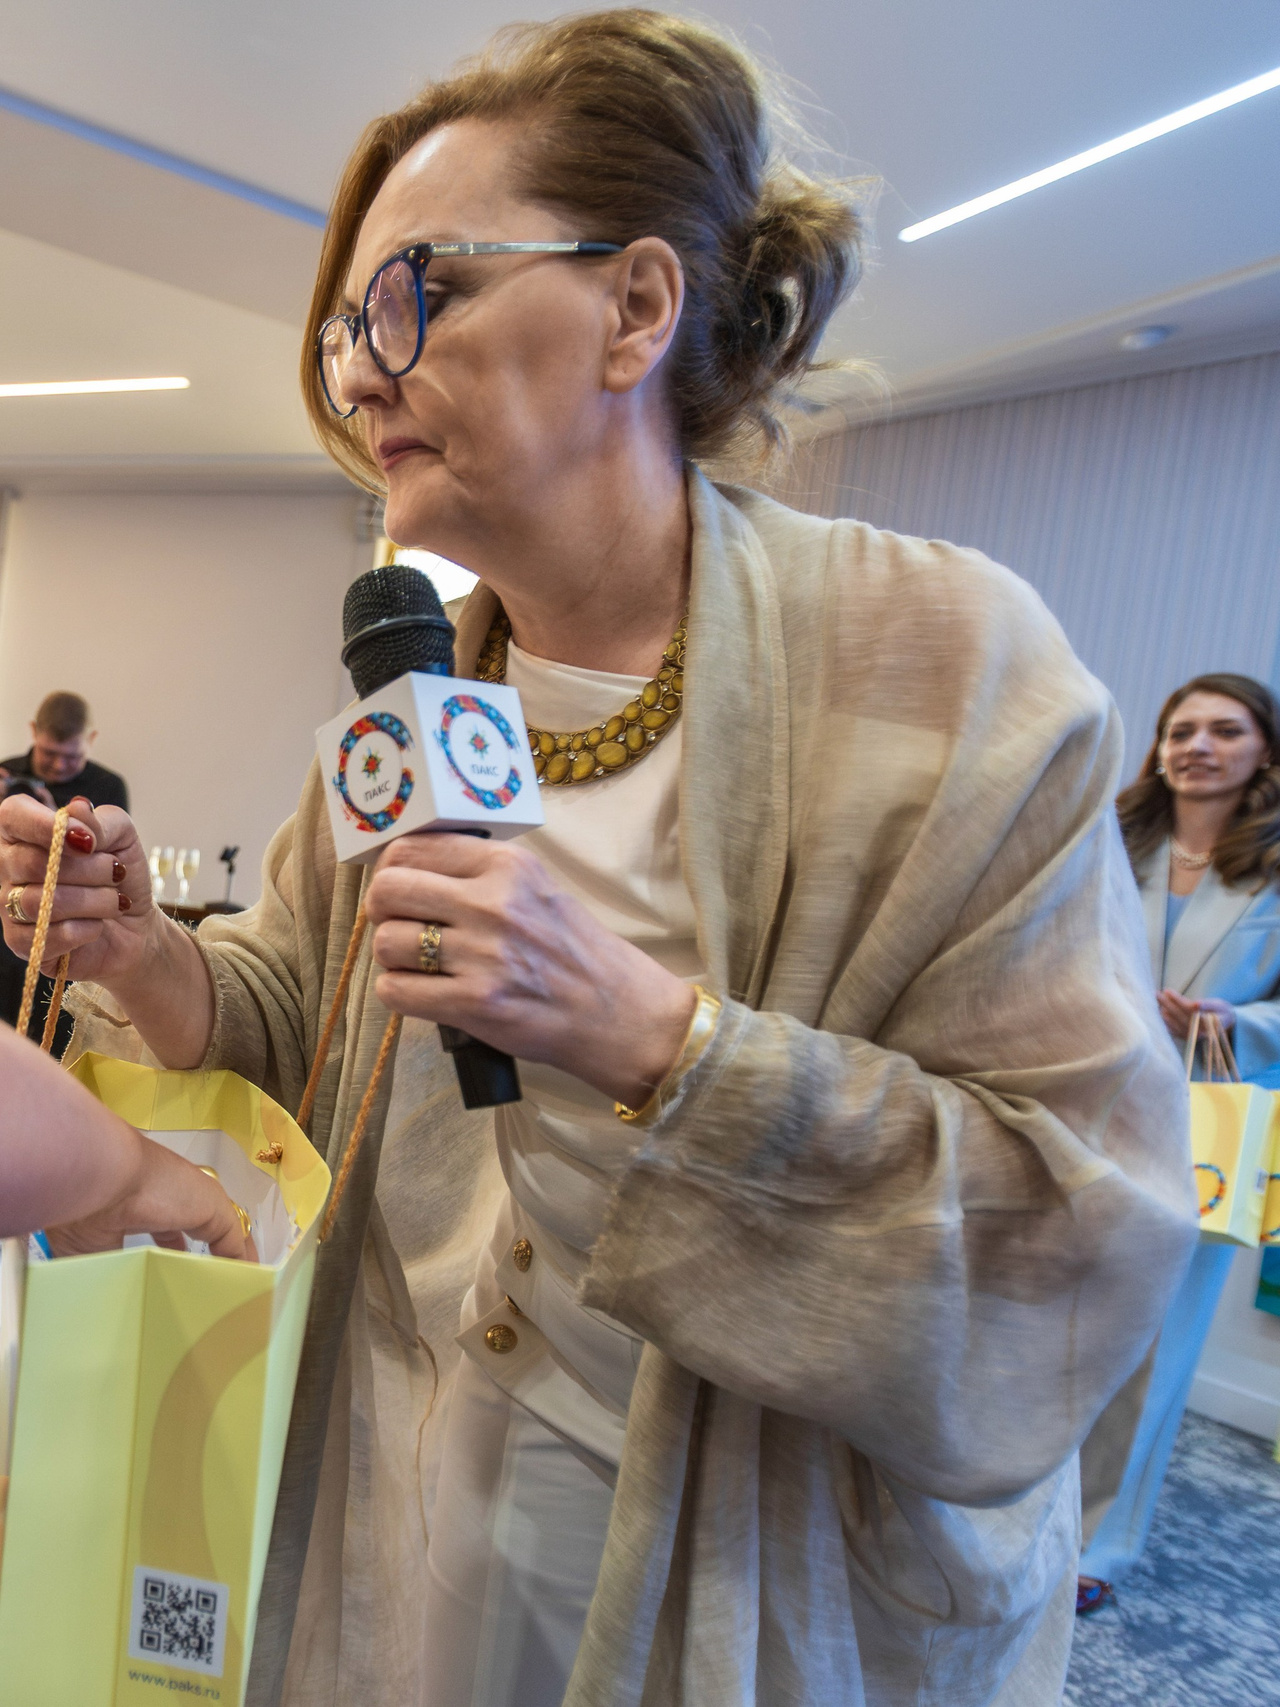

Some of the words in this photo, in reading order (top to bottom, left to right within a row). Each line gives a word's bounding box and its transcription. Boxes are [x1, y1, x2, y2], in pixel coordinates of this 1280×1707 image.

[471, 764, 499, 777] ПАКС
[364, 780, 391, 802] ПАКС
[128, 1670, 220, 1699] www.paks.ru
